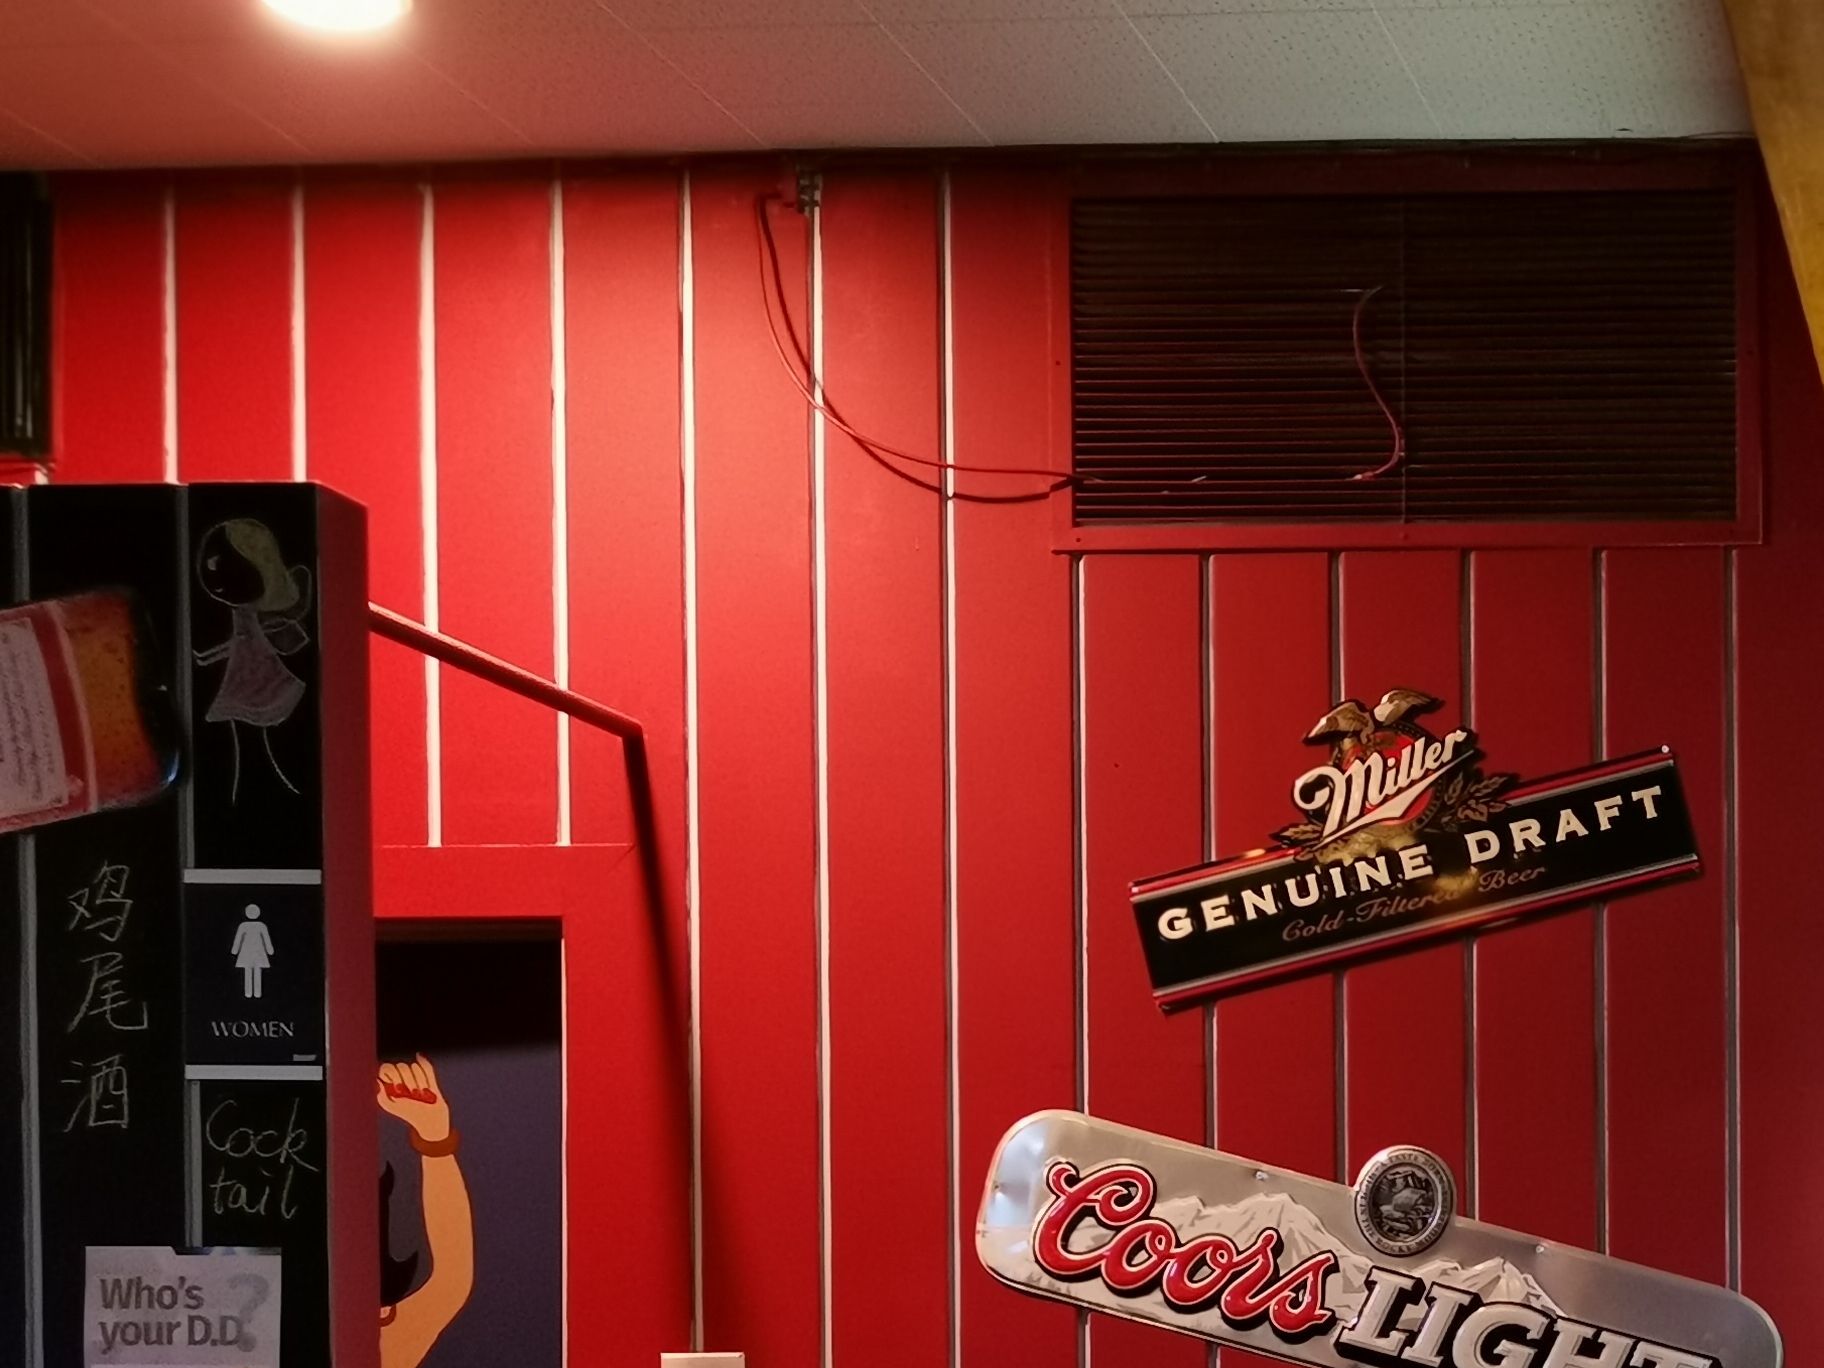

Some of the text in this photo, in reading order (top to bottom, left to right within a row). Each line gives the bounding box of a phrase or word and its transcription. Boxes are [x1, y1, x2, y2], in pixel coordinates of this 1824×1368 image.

[1293, 728, 1474, 848] Miller
[1156, 784, 1664, 942] GENUINE DRAFT
[1478, 866, 1546, 893] Beer
[62, 861, 149, 1133] 鸡尾酒
[210, 1020, 295, 1038] WOMEN
[206, 1097, 319, 1171] Cock
[209, 1165, 298, 1219] tail
[1033, 1157, 1336, 1338] Coors
[100, 1275, 204, 1310] Who's
[100, 1319, 181, 1355] your
